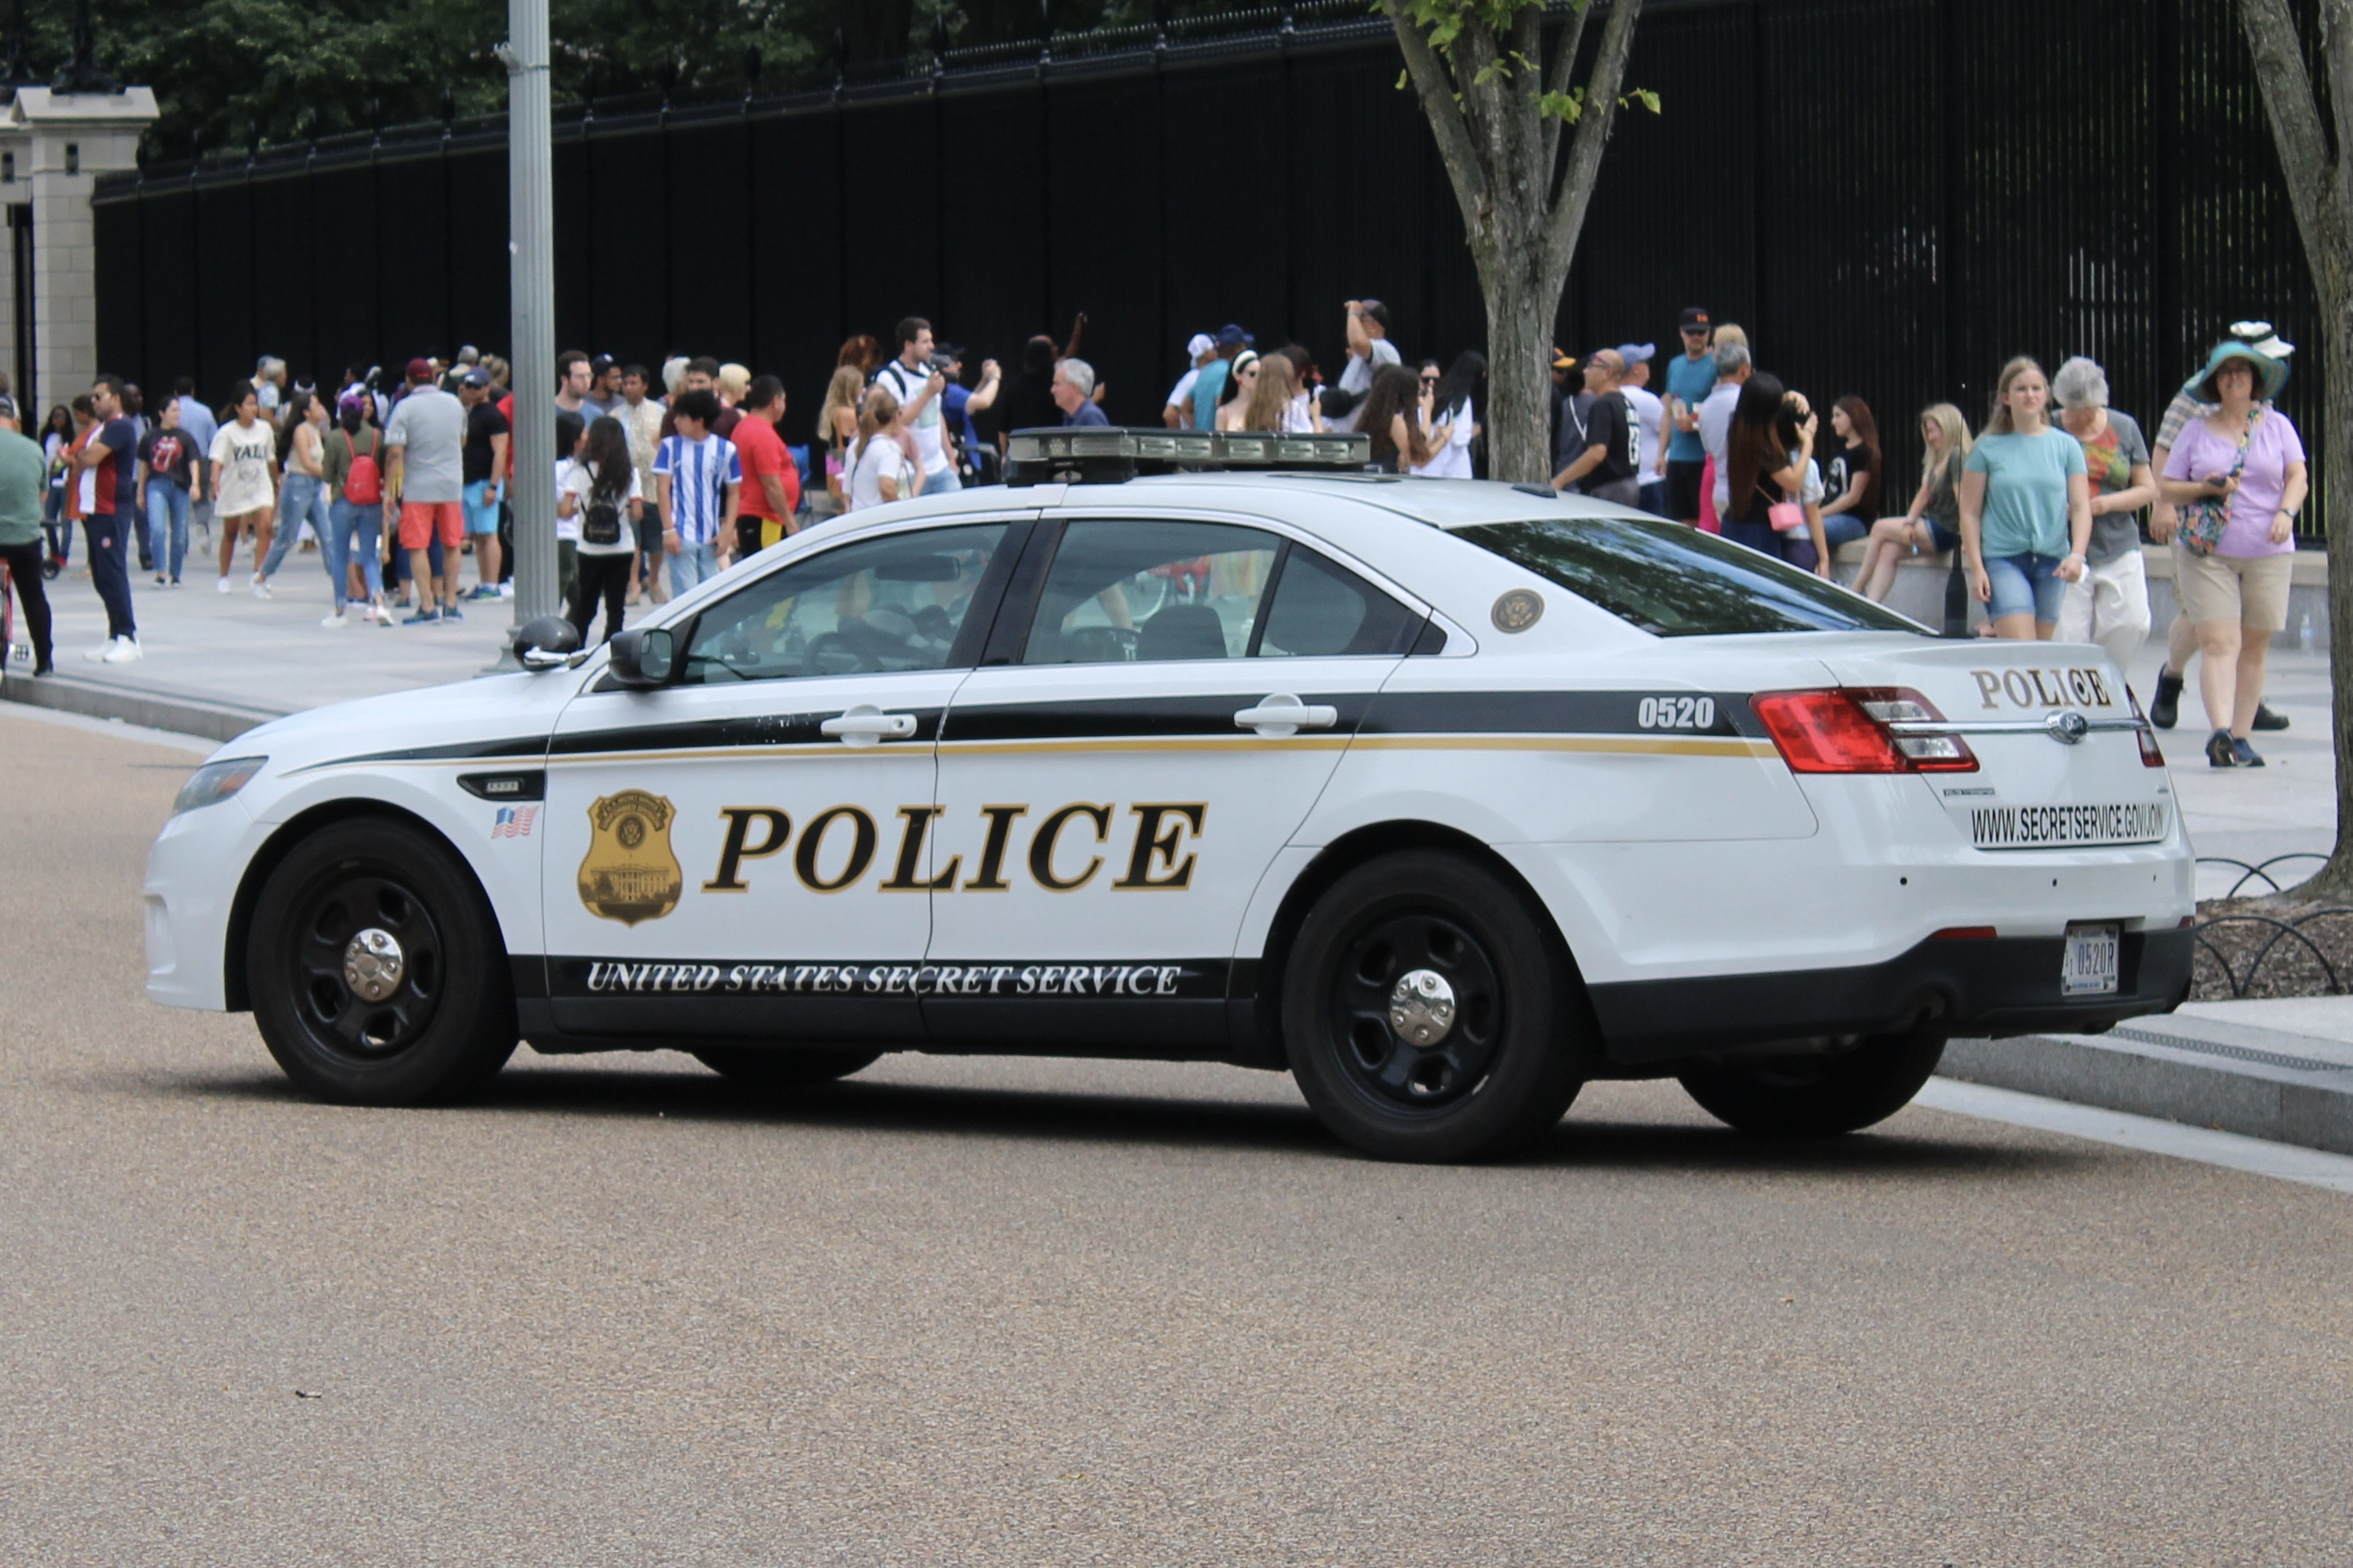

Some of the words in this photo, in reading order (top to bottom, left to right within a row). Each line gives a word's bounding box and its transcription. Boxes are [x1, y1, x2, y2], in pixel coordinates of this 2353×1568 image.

[233, 444, 268, 460] YAL
[1971, 668, 2111, 709] POLICE
[1638, 696, 1714, 728] 0520
[701, 802, 1208, 893] POLICE
[586, 962, 720, 991] UNITED
[725, 964, 859, 991] STATES
[863, 965, 1013, 993] SECRET
[1016, 965, 1182, 995] SERVICE
